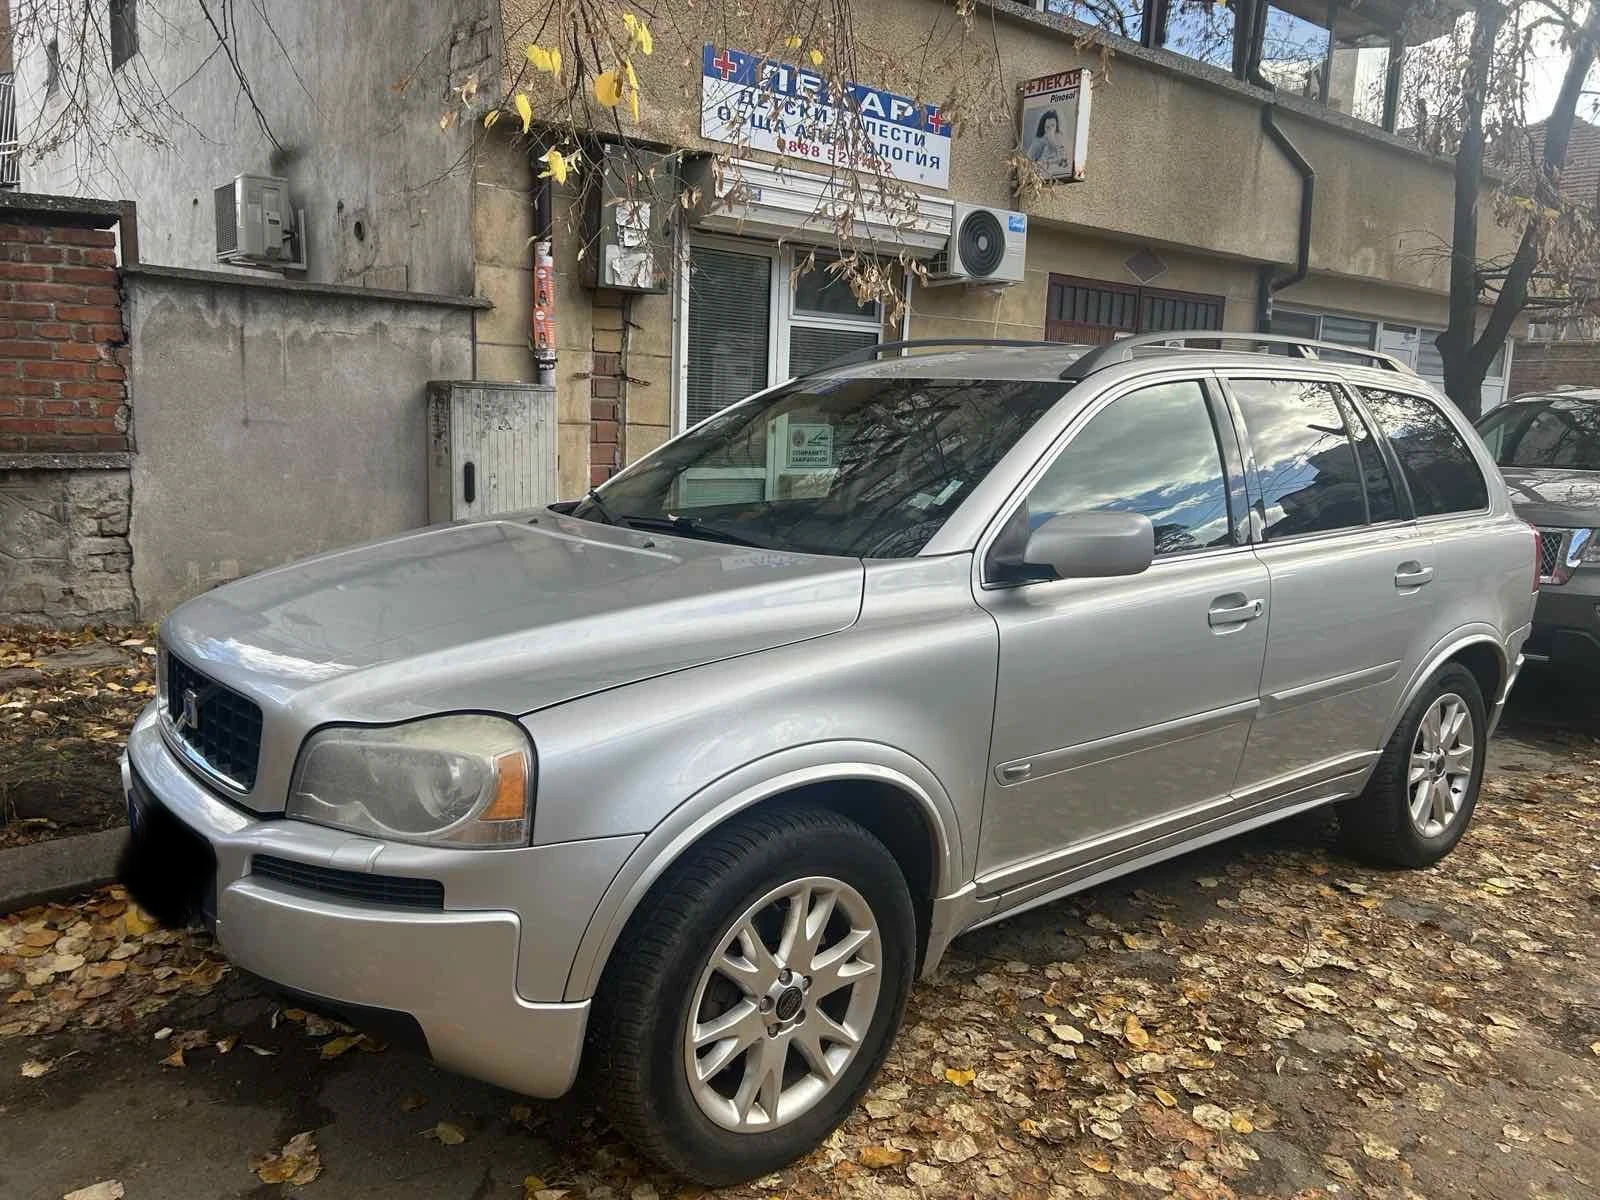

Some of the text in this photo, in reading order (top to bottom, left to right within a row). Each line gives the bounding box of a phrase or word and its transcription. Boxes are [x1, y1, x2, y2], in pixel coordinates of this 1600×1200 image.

[759, 64, 914, 121] ЛЕАР
[1036, 73, 1081, 92] ЛЕКАР
[841, 115, 926, 147] ЛЕСТИ
[778, 139, 820, 158] 888
